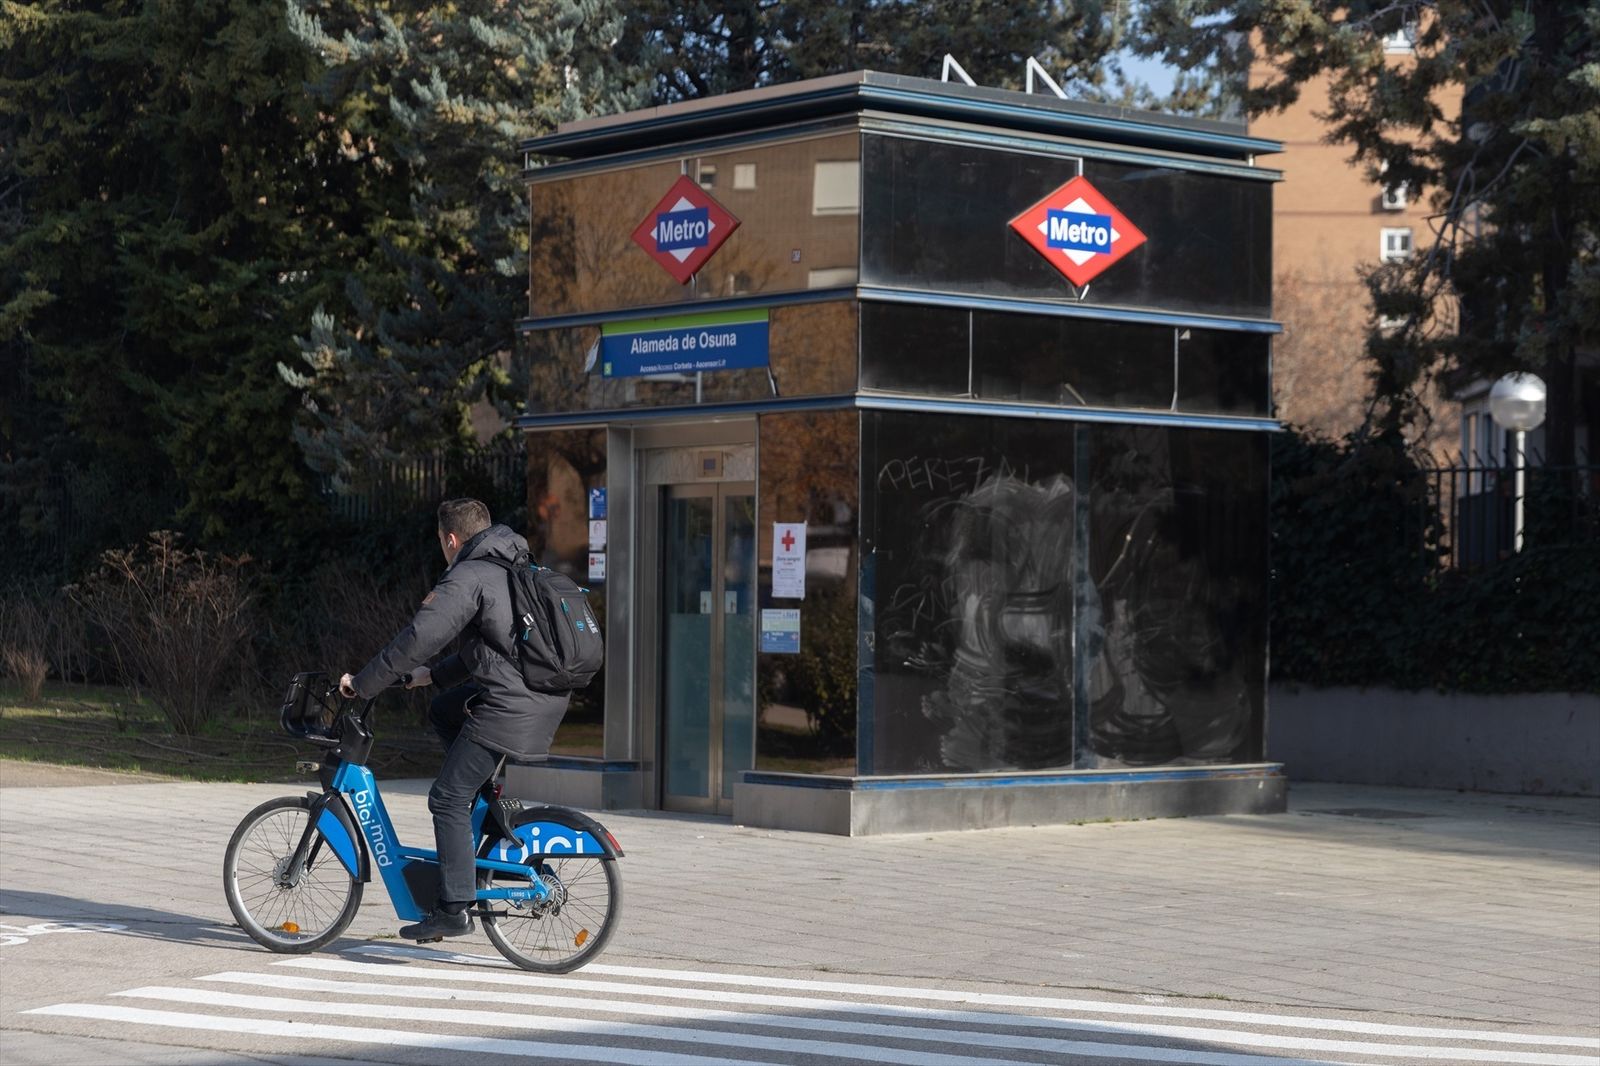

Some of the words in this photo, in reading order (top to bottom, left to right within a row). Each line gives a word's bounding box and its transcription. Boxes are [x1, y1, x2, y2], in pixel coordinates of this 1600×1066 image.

[660, 219, 706, 243] Metro
[1050, 216, 1108, 246] Metro
[630, 335, 679, 354] Alameda
[681, 333, 697, 350] de
[699, 331, 737, 348] Osuna
